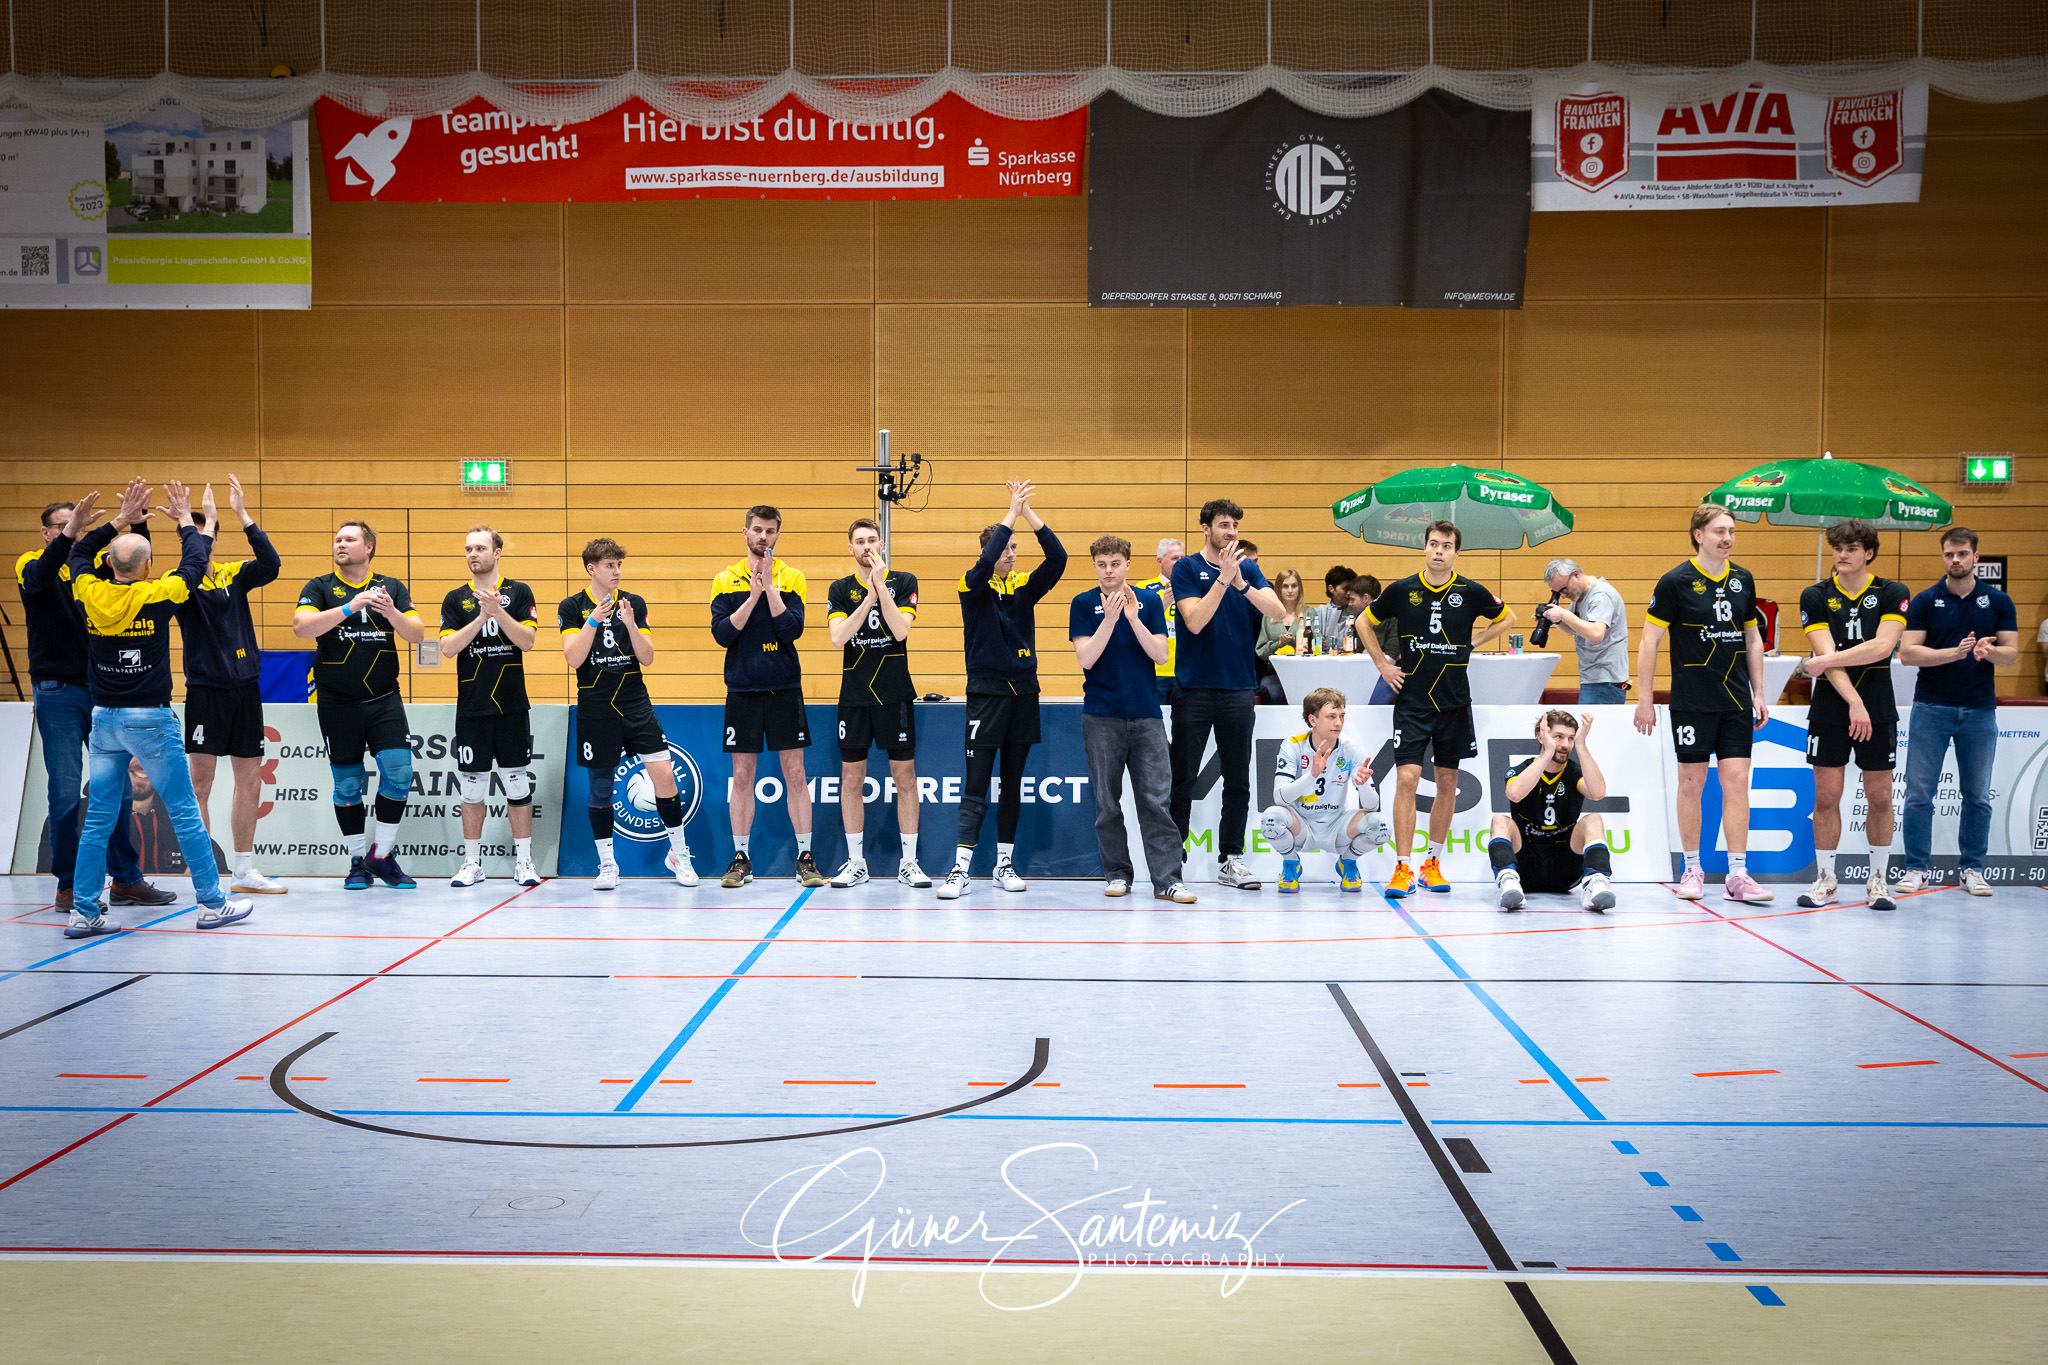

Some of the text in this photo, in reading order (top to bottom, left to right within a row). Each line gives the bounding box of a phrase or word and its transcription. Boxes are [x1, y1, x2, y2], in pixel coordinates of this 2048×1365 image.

[1564, 100, 1620, 116] #AVIATEAM
[1657, 82, 1796, 135] AVIA
[1837, 94, 1893, 111] #AVIATEAM
[1563, 112, 1621, 130] FRANKEN
[1833, 105, 1893, 125] FRANKEN
[24, 128, 48, 137] KfW40
[51, 128, 68, 137] plus
[71, 128, 89, 137] (A+)
[622, 111, 687, 143] Hier
[774, 109, 815, 141] du
[1299, 134, 1324, 142] GYM
[460, 134, 579, 173] gesucht!
[998, 150, 1076, 169] Sparkasse
[1265, 142, 1289, 191] FITNESS
[630, 169, 939, 186] www.sparkasse-nuernberg.de/ausbildung
[999, 170, 1072, 187] Nürnberg
[1308, 144, 1357, 226] PHYSIOTHERAPIE
[1713, 182, 1733, 190] Straße
[80, 200, 103, 211] 2023
[1272, 201, 1292, 220] EMS
[112, 256, 306, 266] PassivEnergie Liegenschaften GmbH & Co.KG
[0, 268, 18, 276] n.de
[1101, 291, 1282, 301] DIEPERSDORFER STRASSE 8, 90571 SCHWAIG
[1443, 292, 1516, 301] INFO@MEGYM.DE
[1340, 493, 1367, 512] Pyraser
[1480, 485, 1534, 503] Pyraser
[1725, 494, 1774, 509] Pyraser
[1898, 501, 1940, 518] Pyraser
[1974, 565, 2001, 577] EIN
[1713, 600, 1732, 621] 13
[482, 617, 498, 637] 10
[868, 610, 880, 630] 6
[1429, 613, 1442, 629] 5
[1845, 618, 1862, 640] 11
[603, 630, 615, 648] 8
[763, 642, 778, 652] MW
[856, 638, 870, 646] Zapf
[1431, 643, 1457, 651] Daigfuss
[236, 648, 246, 659] FH
[1018, 648, 1031, 658] FW
[192, 724, 205, 745] 4
[726, 726, 737, 746] 2
[839, 720, 846, 740] 6
[969, 720, 980, 740] 7
[1393, 730, 1402, 748] 5
[1676, 726, 1696, 745] 13
[1996, 731, 2041, 739] METTERN
[583, 741, 594, 761] 8
[1807, 734, 1819, 757] 11
[457, 745, 474, 765] 10
[1315, 777, 1326, 796] 3
[1544, 806, 1555, 826] 9
[1984, 867, 2015, 881] 0911
[2029, 868, 2046, 881] 50
